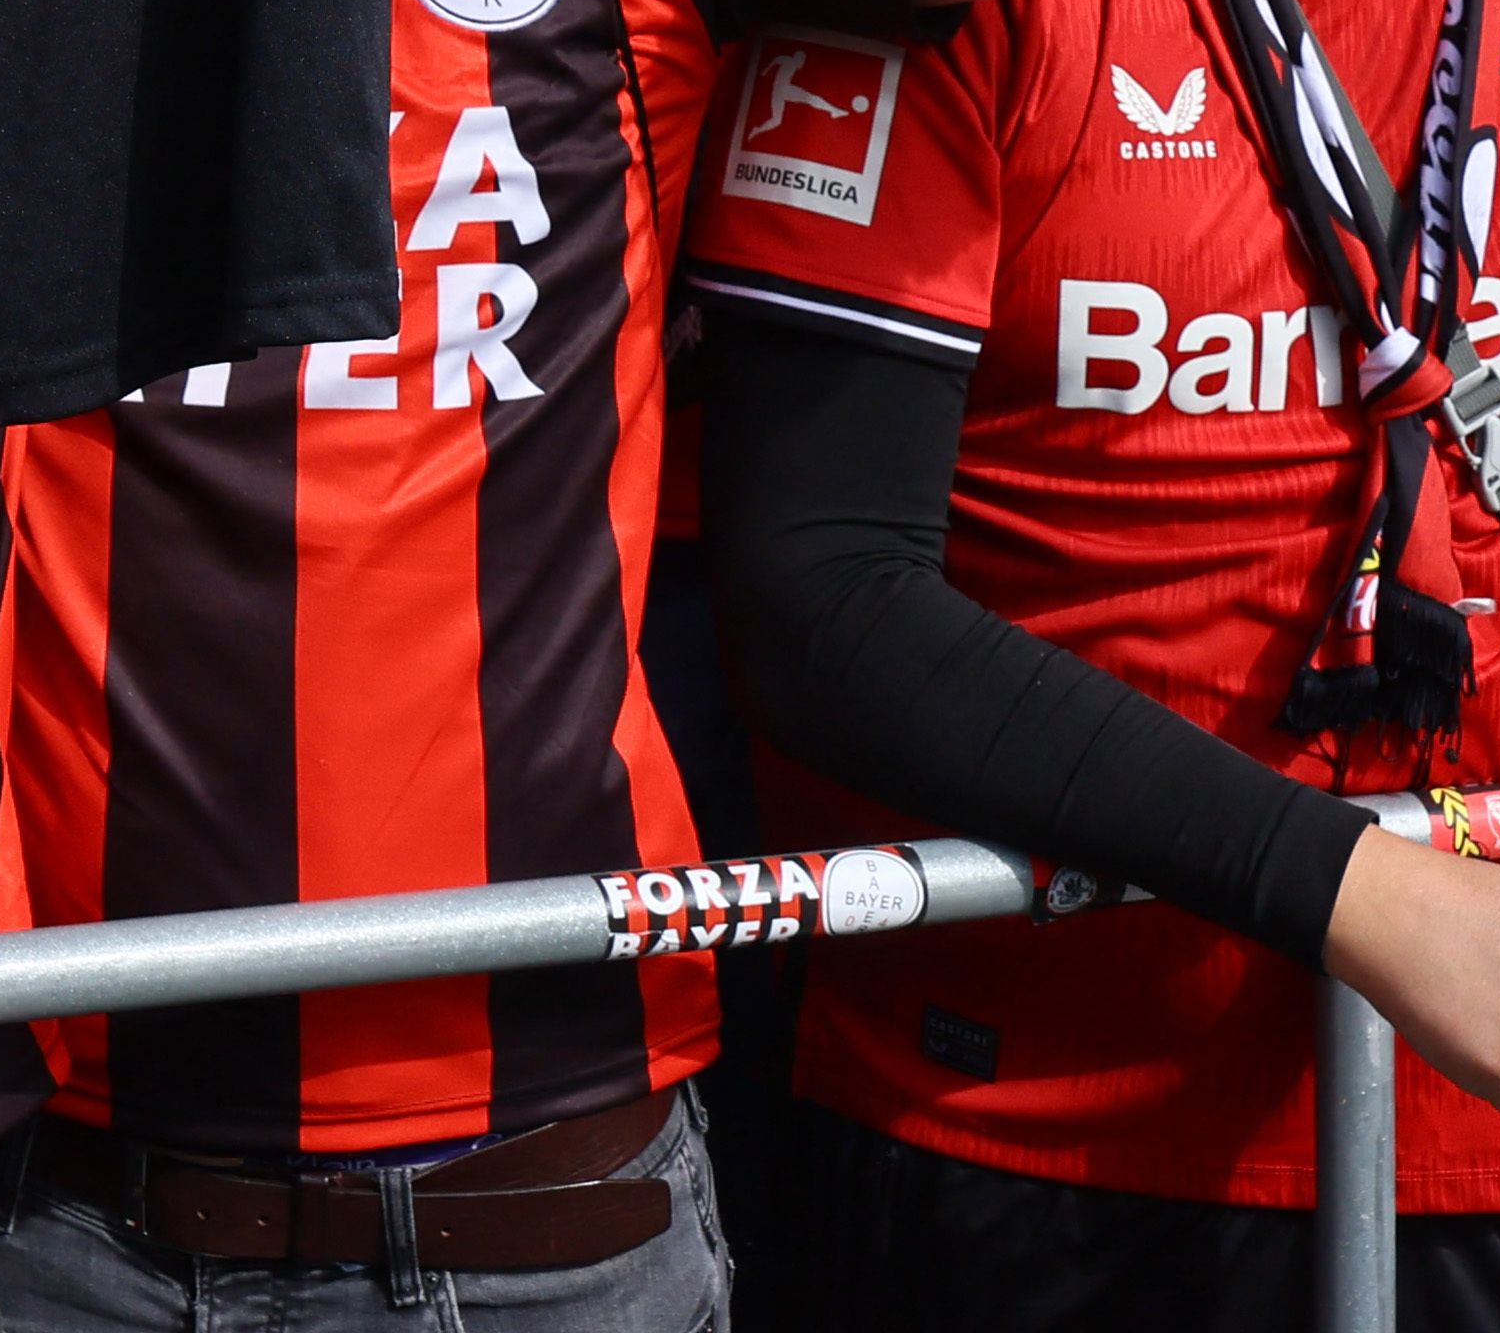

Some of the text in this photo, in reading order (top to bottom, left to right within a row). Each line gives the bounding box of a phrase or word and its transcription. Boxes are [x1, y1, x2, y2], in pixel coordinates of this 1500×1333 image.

[1120, 140, 1218, 160] CASTORE
[733, 162, 860, 205] BUNDESLIGA
[601, 860, 821, 921] FORZA
[843, 889, 903, 912] BAYER
